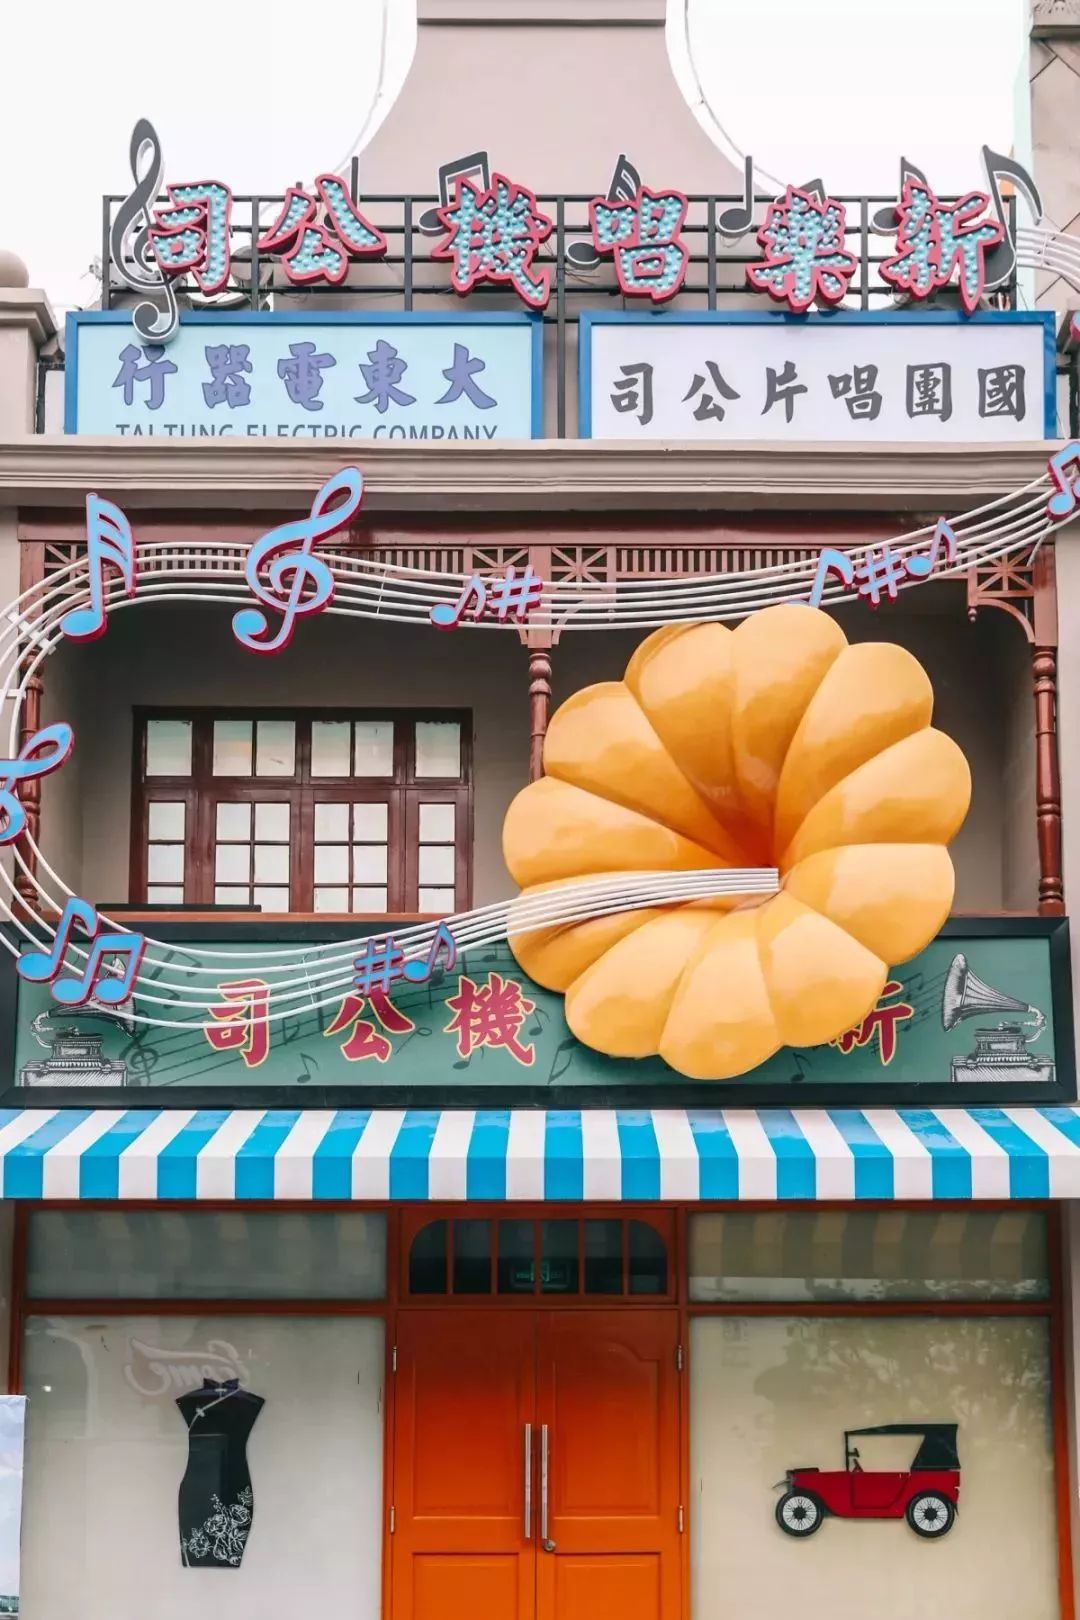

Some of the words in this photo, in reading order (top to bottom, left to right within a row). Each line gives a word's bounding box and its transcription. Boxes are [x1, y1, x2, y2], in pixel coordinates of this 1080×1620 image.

[112, 339, 498, 413] 大東電器行
[373, 425, 498, 440] COMPANY
